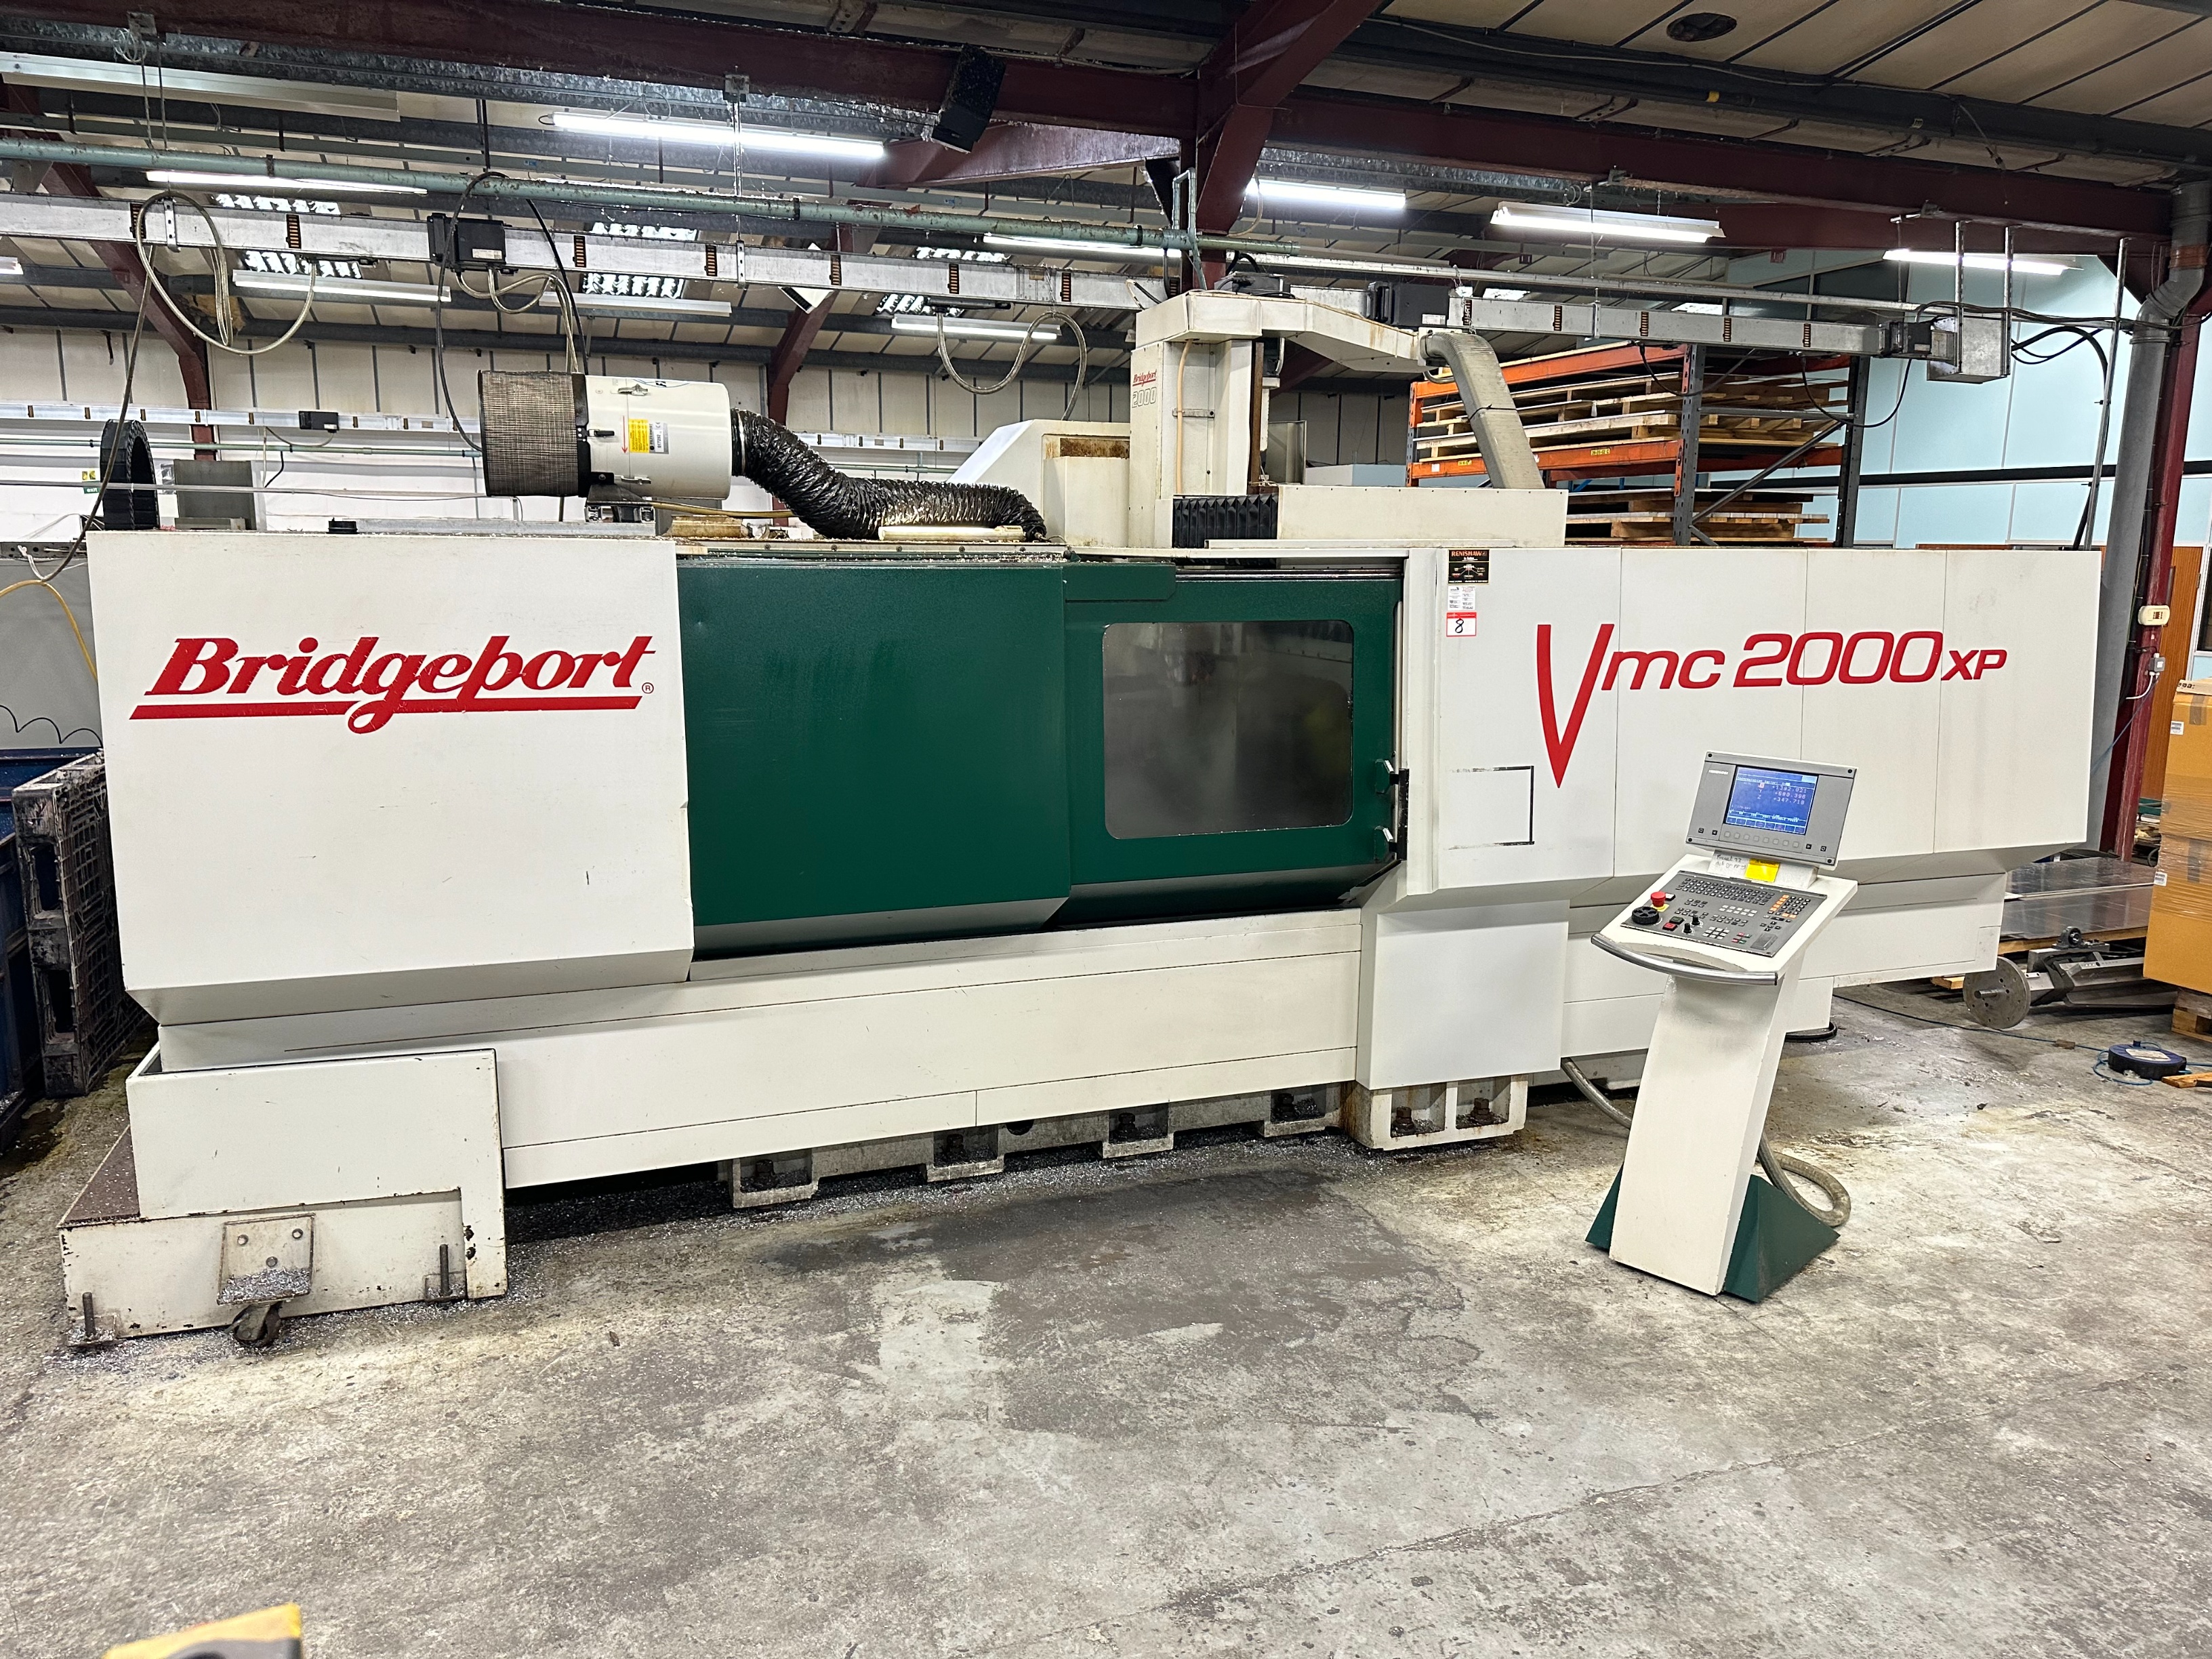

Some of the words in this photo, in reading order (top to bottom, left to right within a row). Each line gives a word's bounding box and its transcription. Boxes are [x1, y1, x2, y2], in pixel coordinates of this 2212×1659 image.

[1133, 369, 1157, 386] Bridgeport
[1132, 387, 1157, 408] 2000
[1454, 617, 1465, 634] 8
[144, 635, 655, 735] Bridgeport
